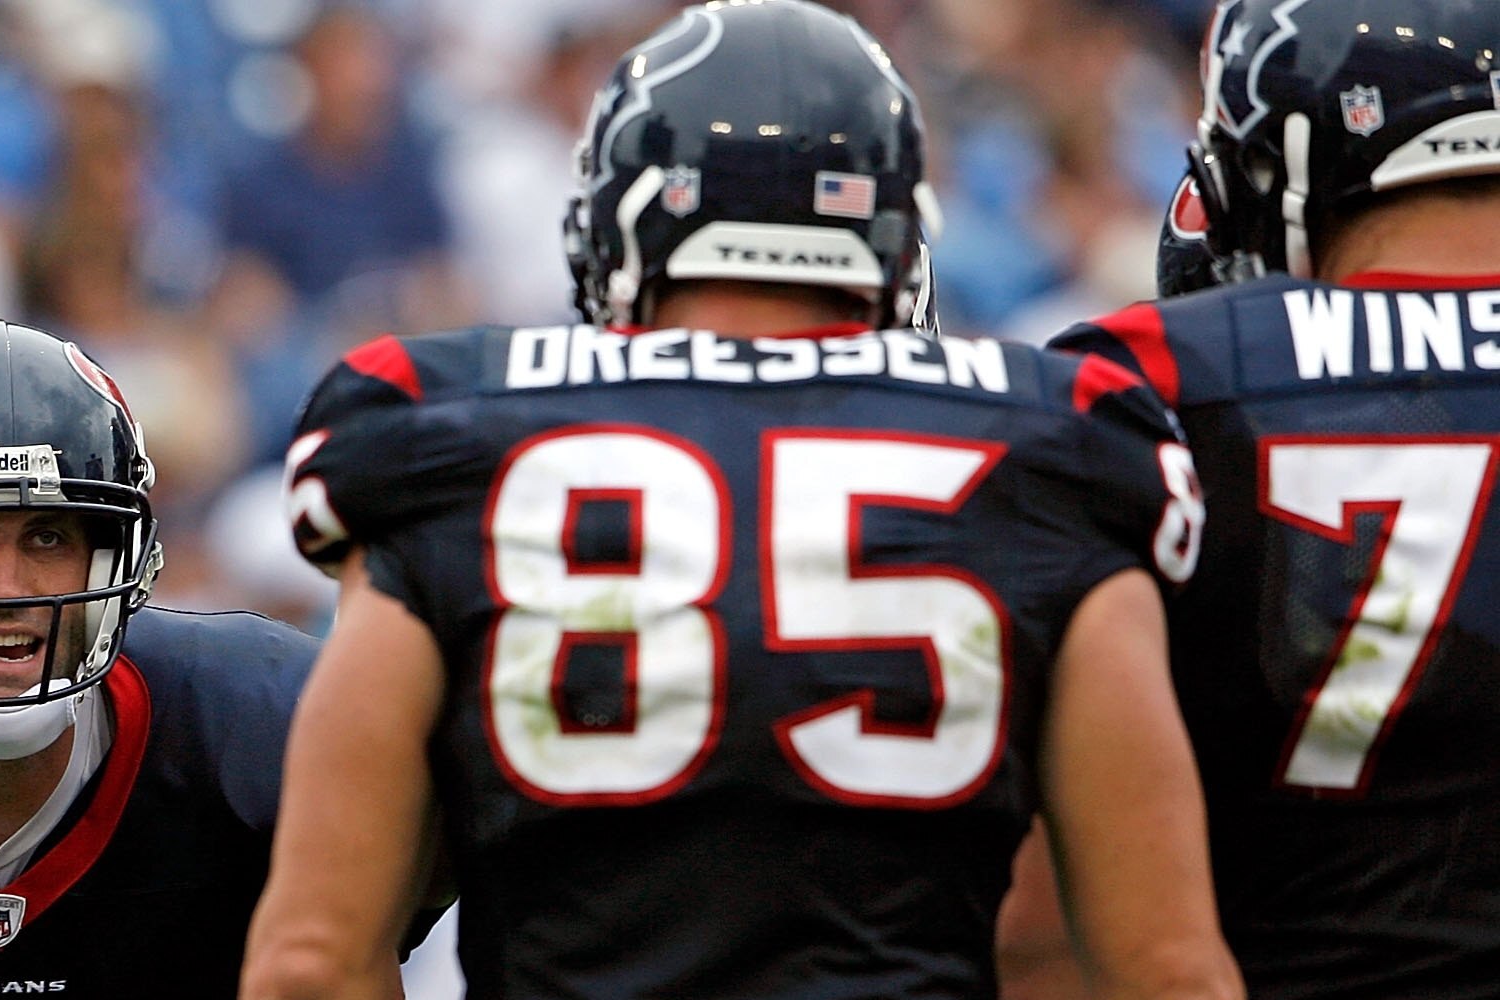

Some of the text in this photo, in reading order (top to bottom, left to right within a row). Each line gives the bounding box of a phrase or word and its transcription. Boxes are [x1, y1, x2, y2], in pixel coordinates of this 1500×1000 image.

[712, 246, 854, 268] TEXANS
[483, 423, 1013, 808] 85
[1256, 434, 1500, 797] 7
